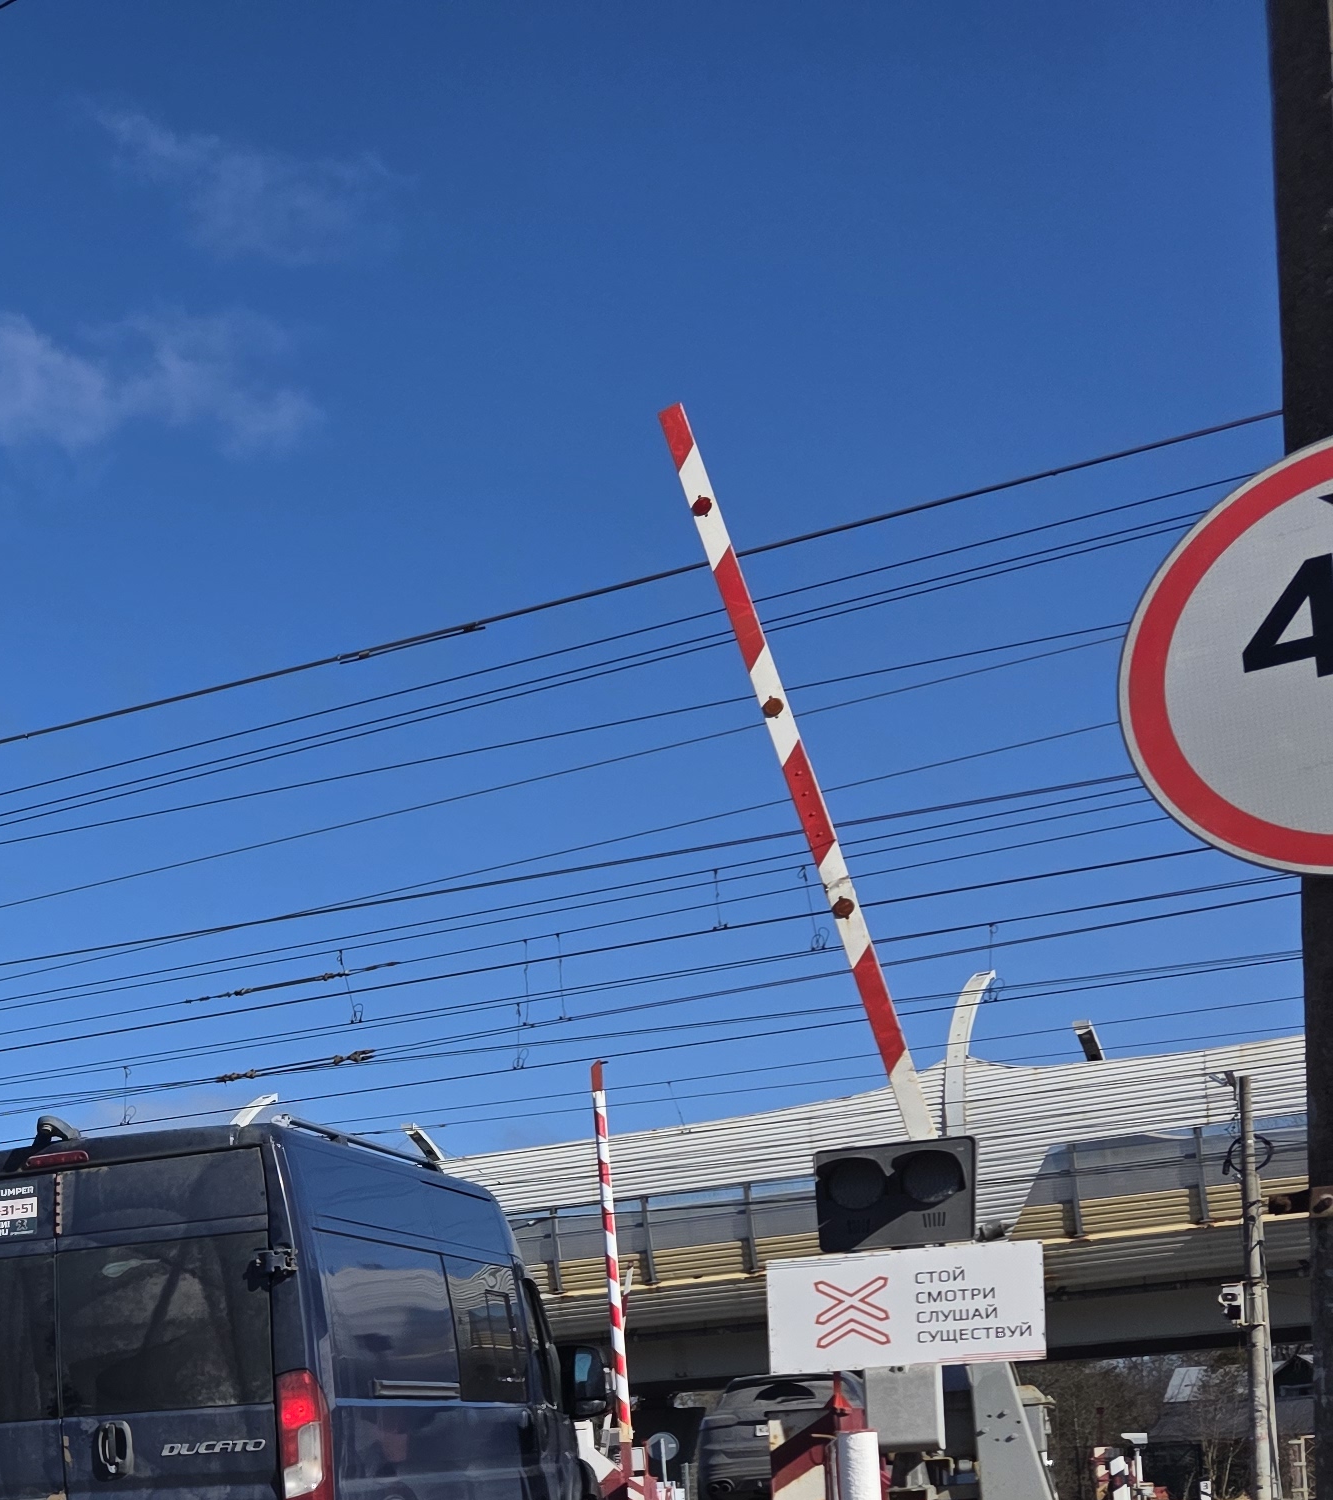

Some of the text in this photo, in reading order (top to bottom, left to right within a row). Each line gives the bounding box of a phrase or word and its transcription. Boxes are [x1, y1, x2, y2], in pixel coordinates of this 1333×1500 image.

[914, 1265, 966, 1285] СТОЙ
[915, 1286, 996, 1304] СМОТРИ
[916, 1303, 998, 1324] СЛУШАЙ
[917, 1321, 1033, 1344] СУЩЕСТВУЙ
[161, 1439, 266, 1456] DUCATO
